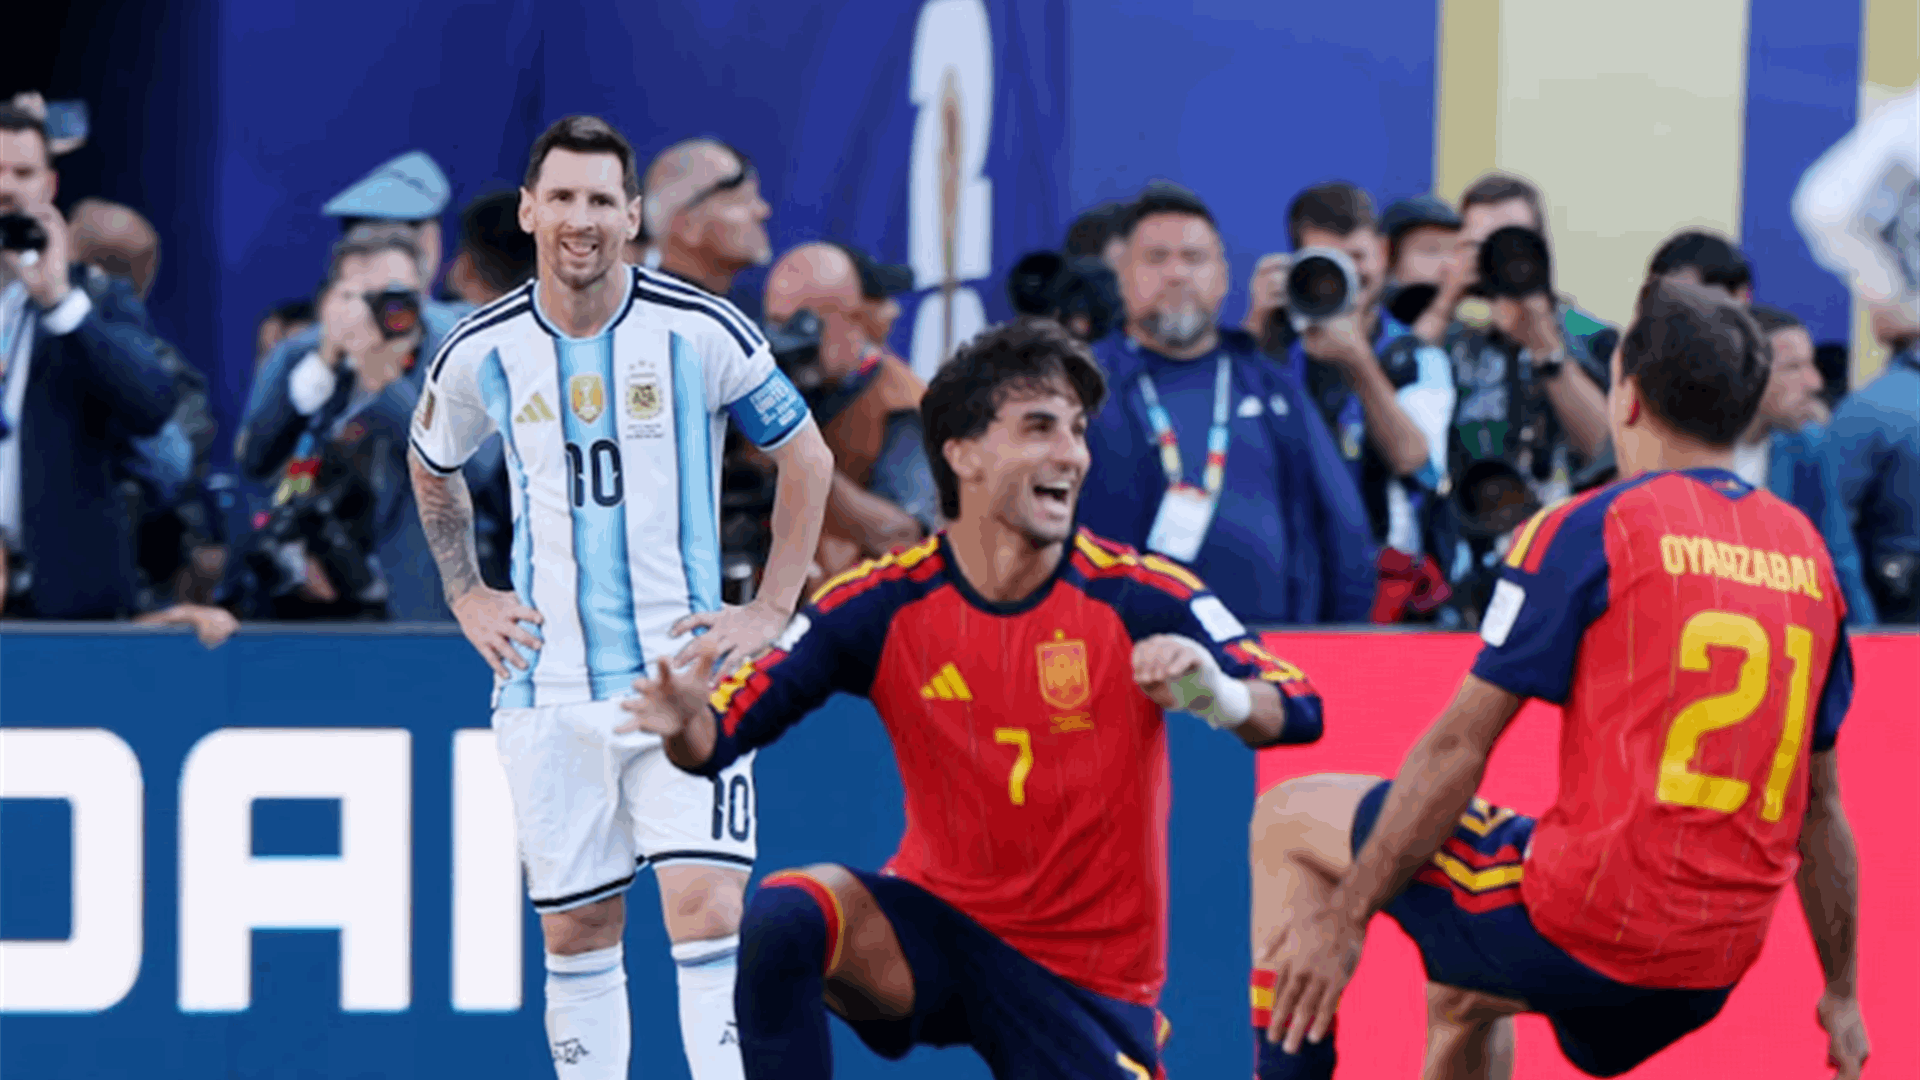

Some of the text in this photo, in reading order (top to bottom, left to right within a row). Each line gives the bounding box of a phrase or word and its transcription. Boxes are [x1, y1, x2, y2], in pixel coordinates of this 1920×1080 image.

[565, 439, 624, 508] 10
[1660, 534, 1824, 600] OYARZABAL
[1656, 609, 1813, 822] 21
[994, 728, 1034, 805] 7
[711, 773, 750, 843] 10
[0, 728, 523, 1012] DAI
